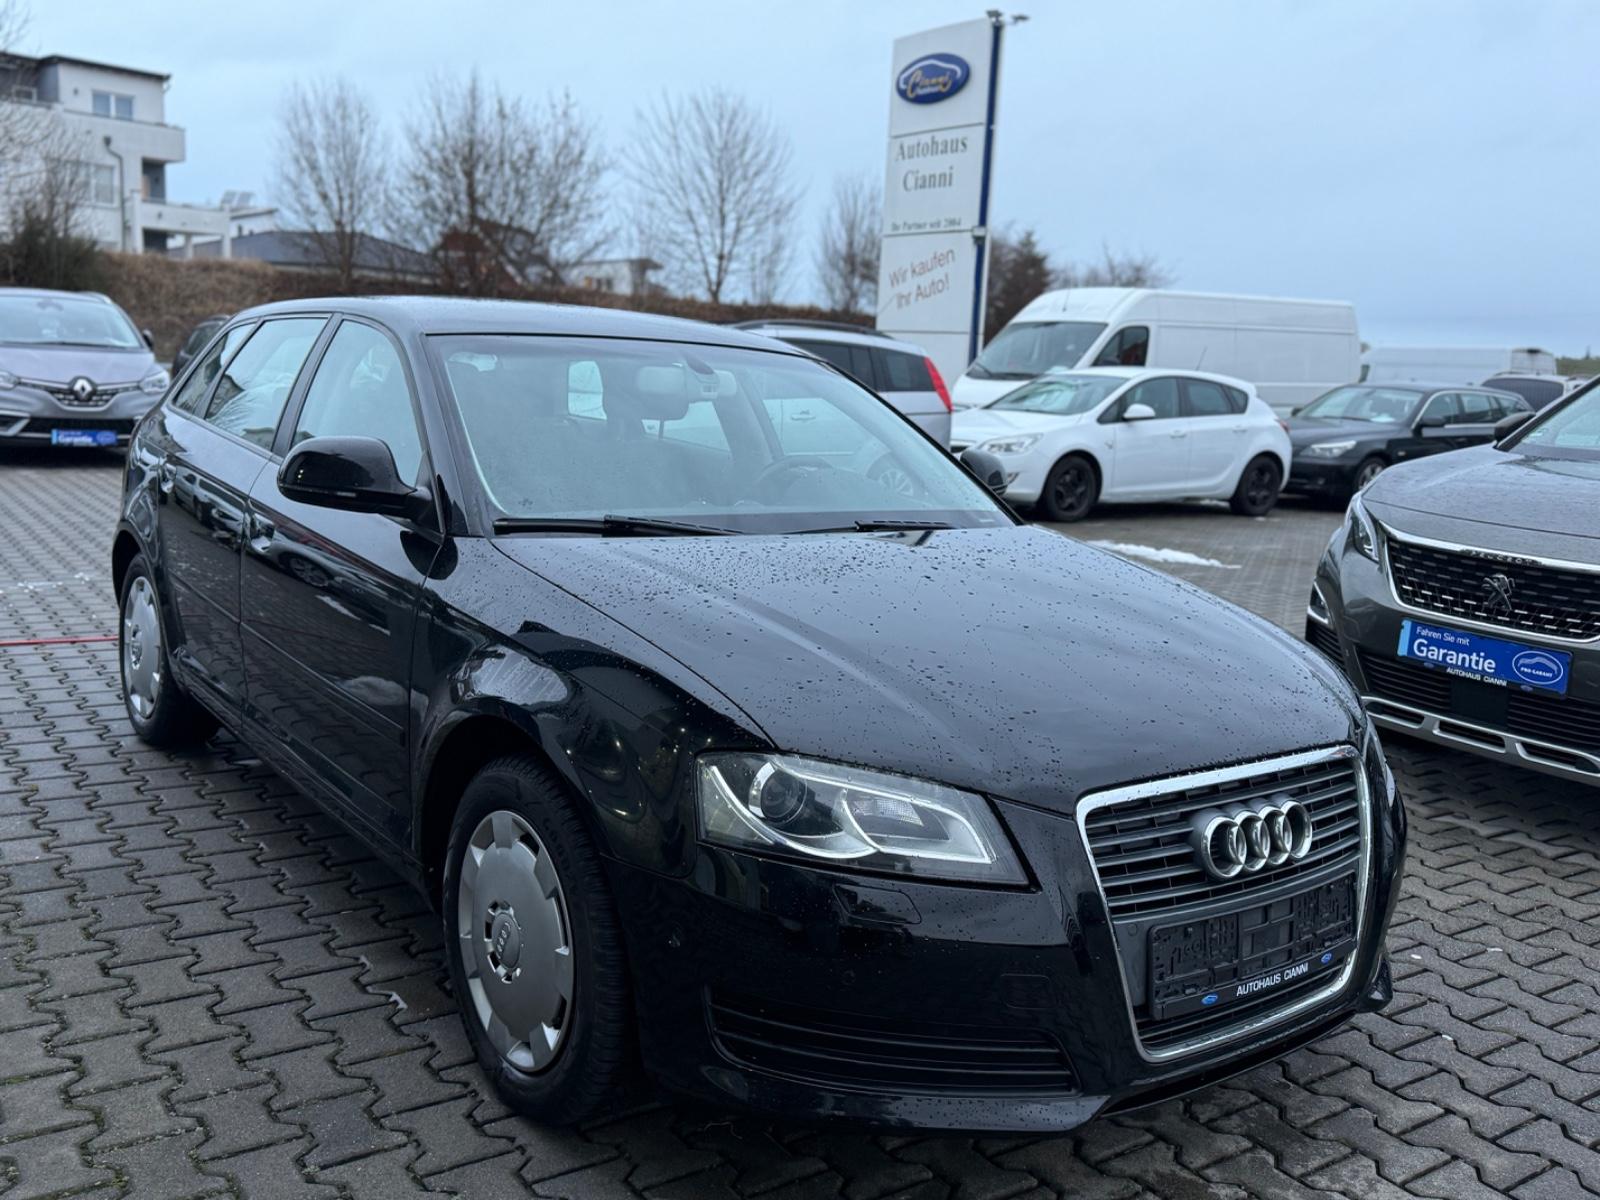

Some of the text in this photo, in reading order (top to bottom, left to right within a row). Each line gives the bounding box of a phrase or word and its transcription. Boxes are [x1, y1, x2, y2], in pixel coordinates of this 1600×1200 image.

[895, 134, 968, 161] Autohaus
[903, 165, 953, 192] Cianni
[889, 248, 956, 289] Wir kaufen
[896, 271, 950, 310] Ihr Auto!
[1416, 626, 1470, 646] Fahren Sie mit
[1413, 638, 1496, 673] Garantie
[1446, 667, 1508, 687] AUTOHAUS CIANNI
[1236, 962, 1309, 997] AUTOHAUS CIANNI
